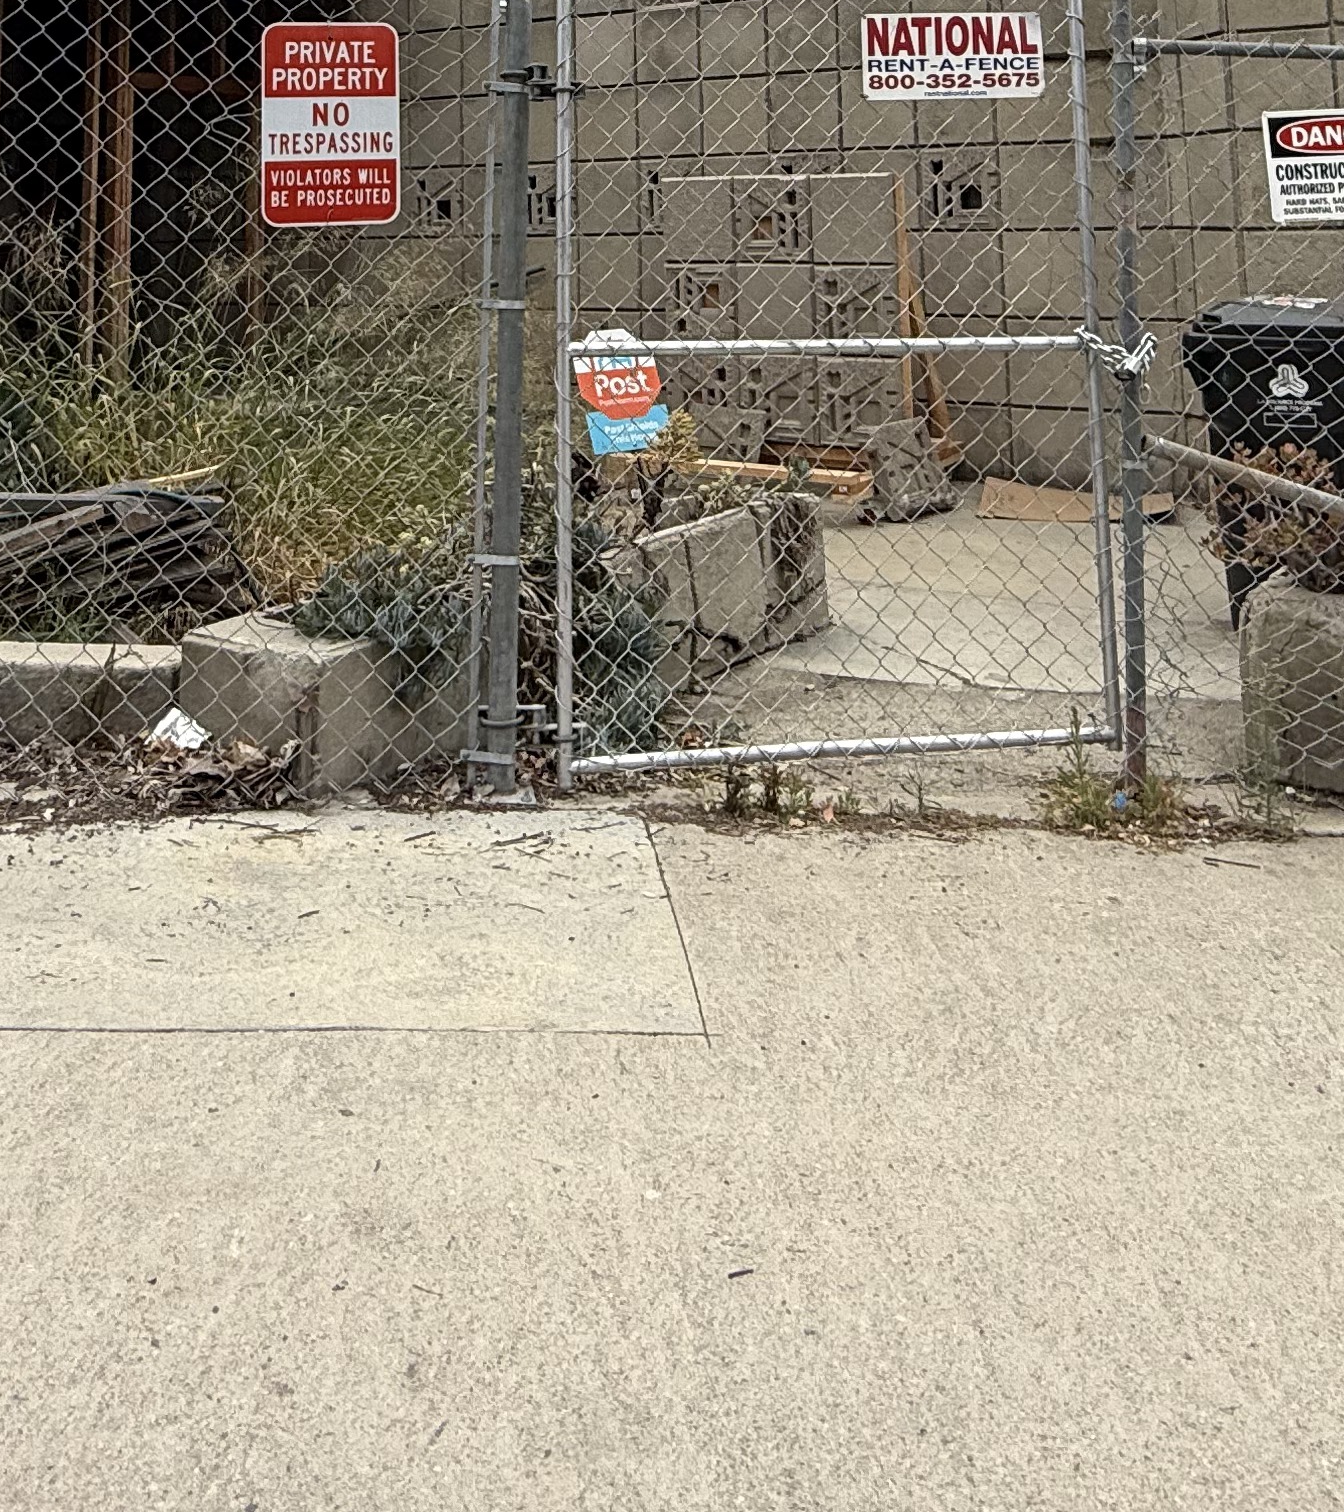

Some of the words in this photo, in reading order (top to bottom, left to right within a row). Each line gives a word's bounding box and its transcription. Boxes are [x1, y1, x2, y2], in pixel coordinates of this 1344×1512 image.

[867, 15, 1039, 57] NATIONAL
[284, 41, 376, 64] PRIVATE
[868, 57, 1040, 73] RENT-A-FENCE
[272, 67, 388, 91] PROPERTY
[868, 72, 1040, 90] 800-352-5675
[312, 102, 350, 127] NO
[268, 131, 393, 155] TRESPASSING
[270, 168, 351, 187] VIOLATORS
[358, 168, 391, 184] WILL
[270, 190, 289, 207] BE
[297, 188, 391, 206] PROSECUTED
[1280, 182, 1335, 196] AUTHORIZED
[1283, 206, 1333, 215] SUBSTANTIAL
[1286, 198, 1307, 206] HARD
[595, 370, 652, 397] Post
